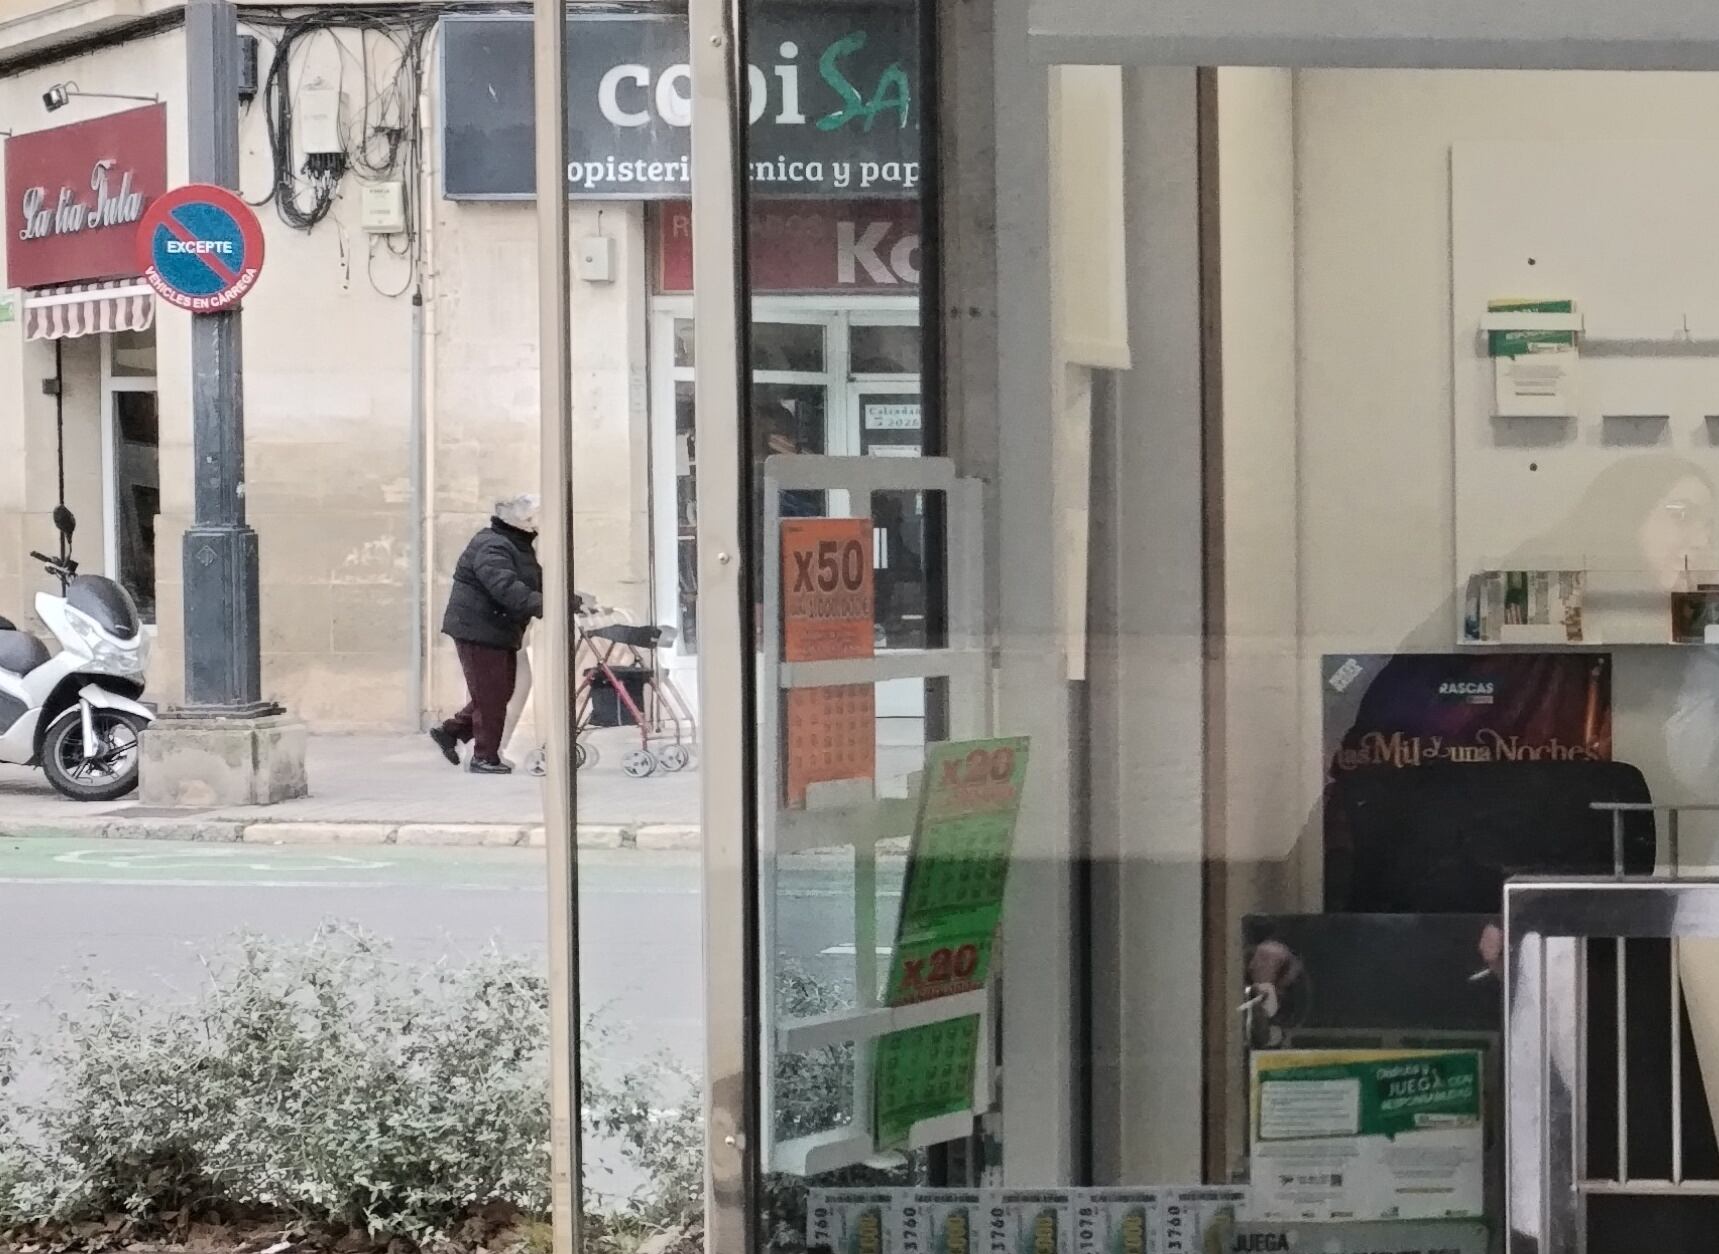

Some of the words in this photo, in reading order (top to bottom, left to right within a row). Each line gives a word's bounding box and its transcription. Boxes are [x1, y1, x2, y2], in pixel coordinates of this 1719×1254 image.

[567, 156, 691, 187] opisteri
[832, 162, 850, 186] y
[88, 159, 143, 229] Tula
[167, 241, 232, 254] EXCEPTE
[145, 266, 192, 307] VEHICLES
[193, 299, 208, 310] EN
[793, 539, 864, 593] x50
[1439, 682, 1494, 694] RASCAS
[1361, 731, 1421, 768] Mil
[902, 943, 979, 989] x20
[1231, 1232, 1290, 1253] JUEGA
